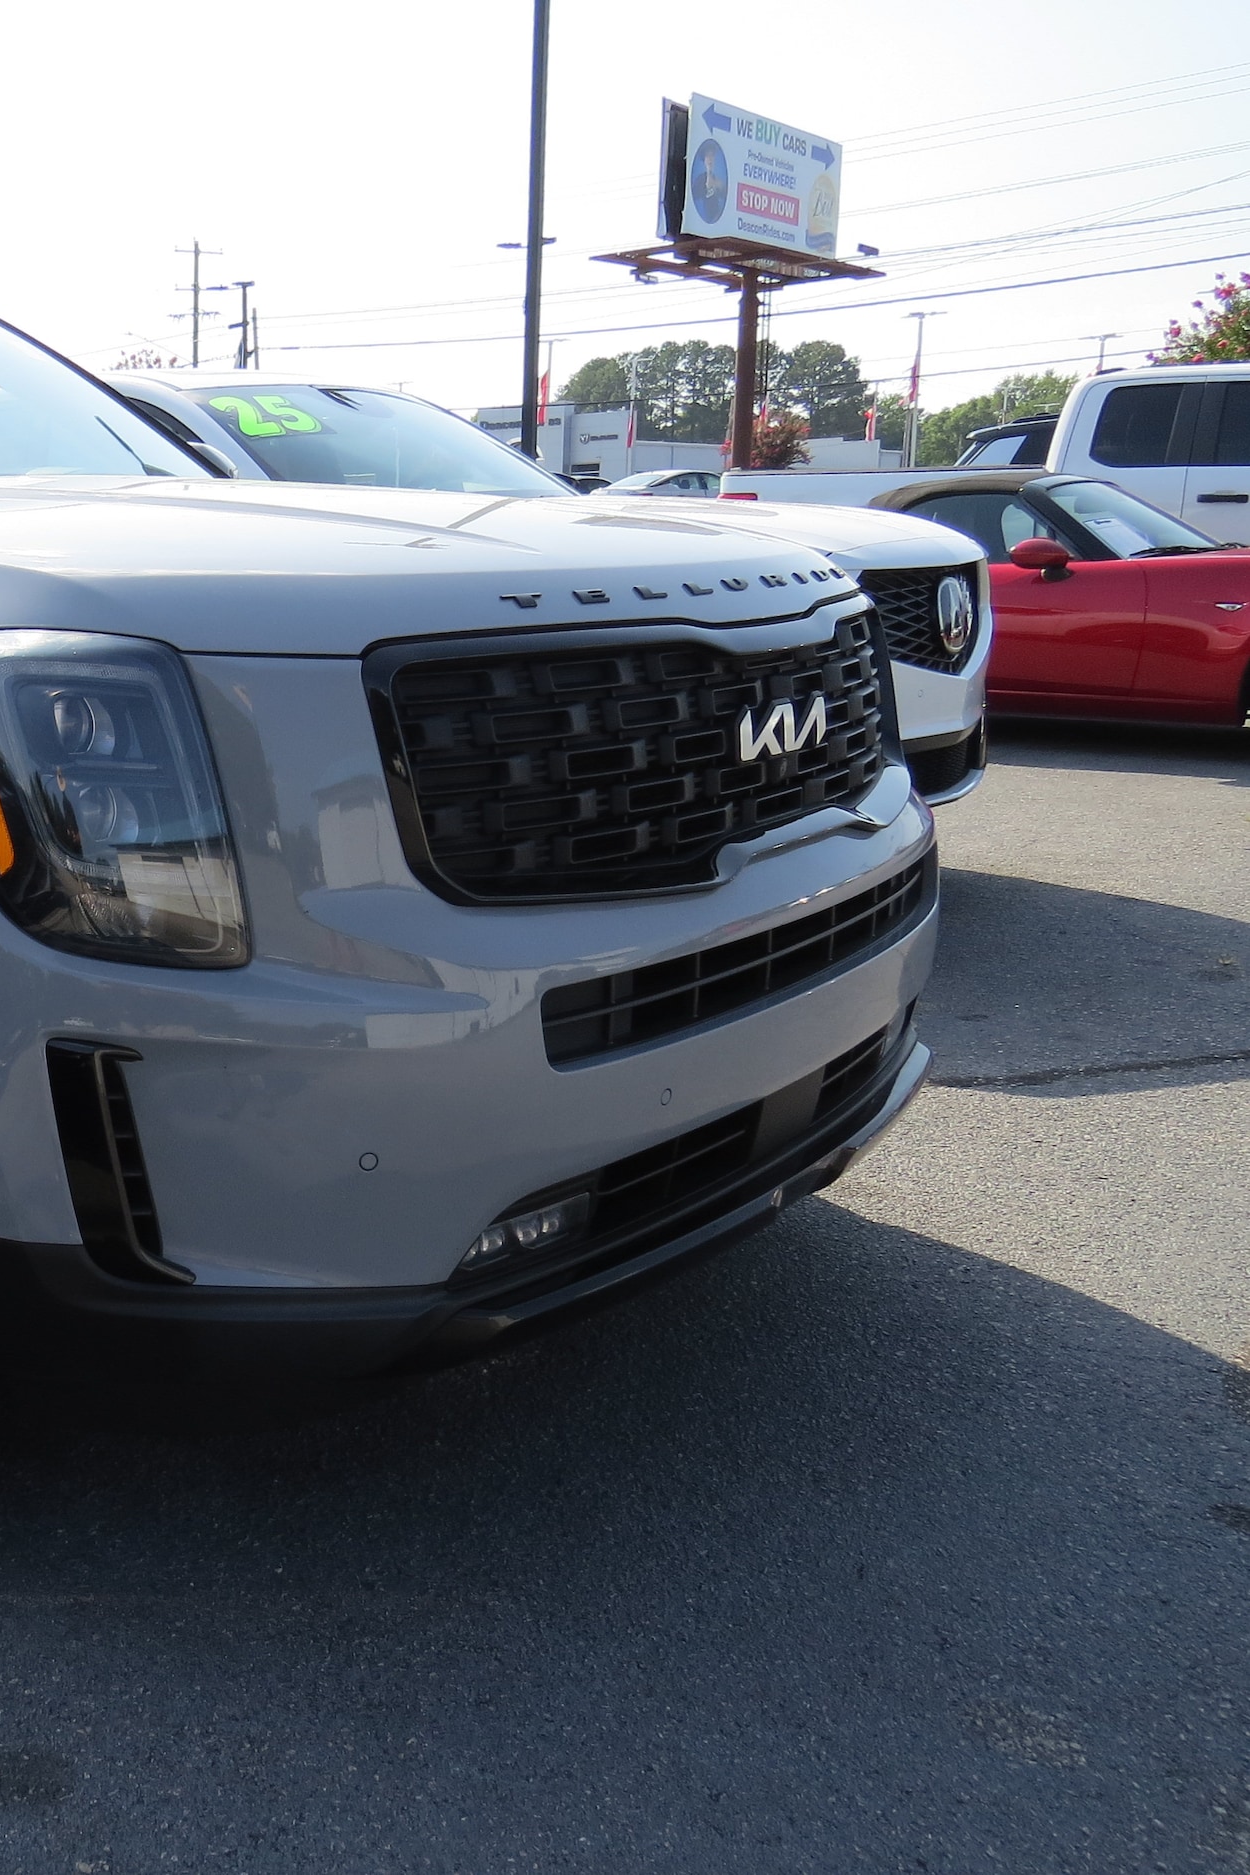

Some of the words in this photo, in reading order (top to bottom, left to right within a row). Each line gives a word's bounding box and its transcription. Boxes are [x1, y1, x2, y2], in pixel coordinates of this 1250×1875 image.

[737, 117, 753, 140] WE
[755, 119, 781, 147] BUY
[783, 133, 807, 157] CARS
[743, 162, 797, 190] EVERYWHERE!
[741, 190, 769, 212] STOP
[770, 197, 795, 219] NOW
[737, 218, 796, 242] DeaconRides.com
[208, 394, 323, 437] 25
[499, 566, 847, 609] TELLURIDE
[739, 695, 827, 763] KIA
